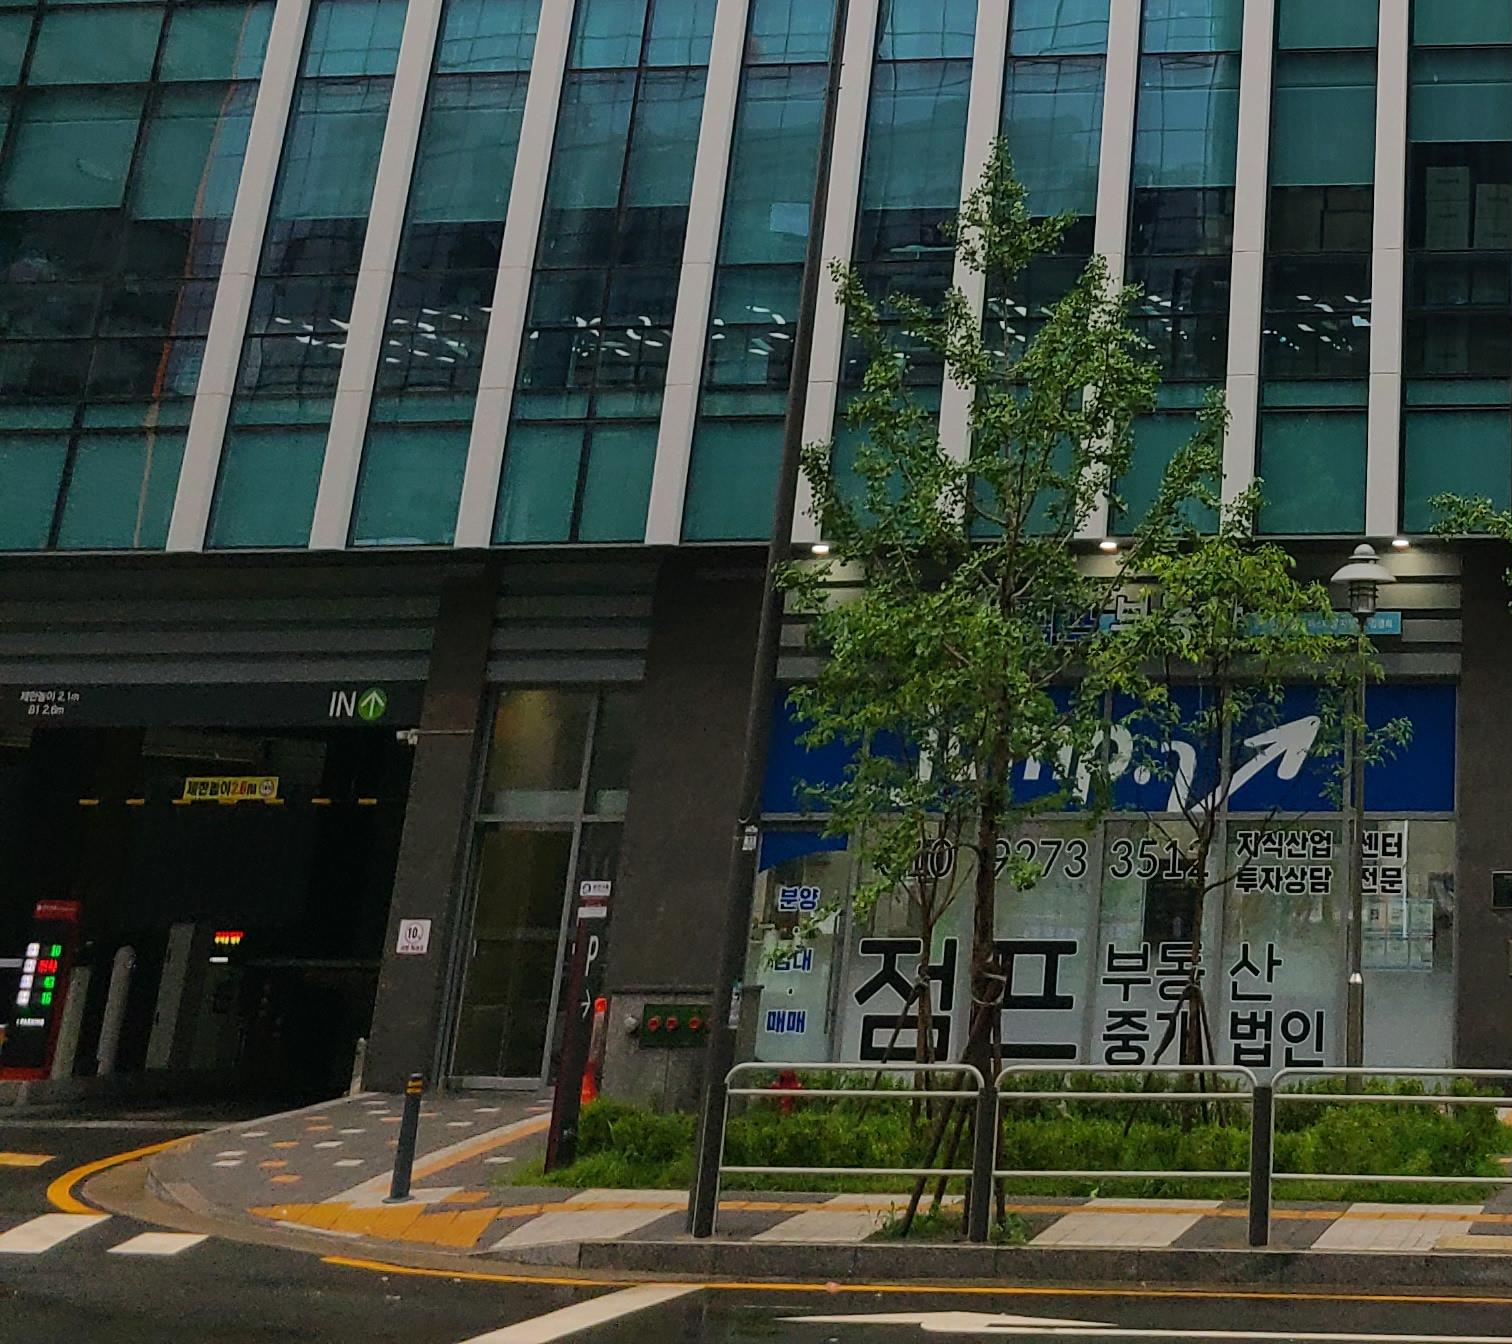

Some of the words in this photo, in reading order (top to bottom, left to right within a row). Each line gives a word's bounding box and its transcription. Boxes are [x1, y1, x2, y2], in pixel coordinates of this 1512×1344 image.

[329, 691, 357, 717] IN
[1110, 837, 1209, 880] 3512
[1234, 865, 1333, 895] 투자상담
[1361, 865, 1404, 895] 전문
[778, 886, 821, 912] 분양
[585, 935, 599, 977] P
[853, 937, 1078, 1062] 점프
[765, 1010, 808, 1035] 매매
